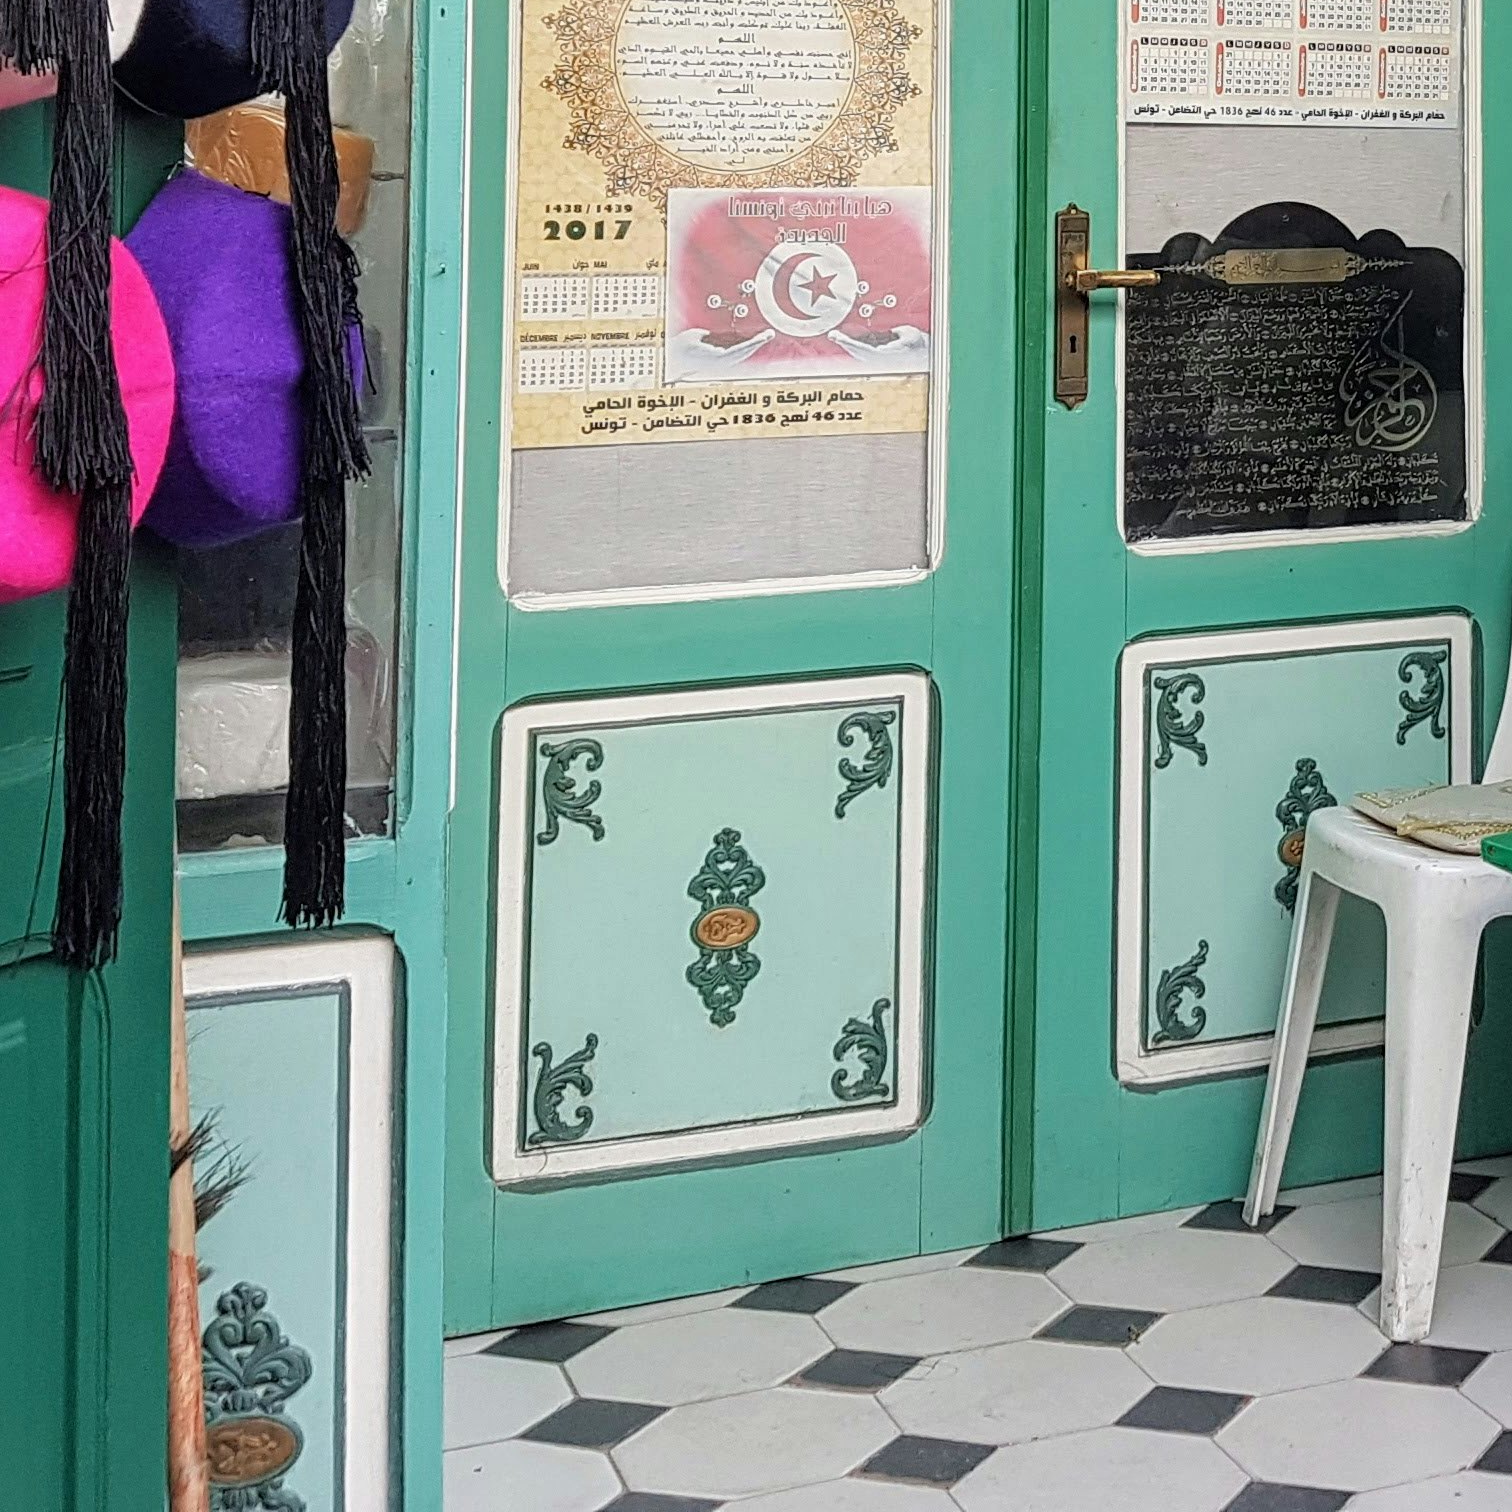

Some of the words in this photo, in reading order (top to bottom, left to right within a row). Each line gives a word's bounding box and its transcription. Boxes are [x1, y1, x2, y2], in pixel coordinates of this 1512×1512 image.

[1220, 106, 1243, 115] 1836
[1264, 107, 1276, 116] 46
[544, 220, 633, 241] 2017
[583, 394, 632, 418] الحامي
[701, 392, 757, 412] الغفران
[762, 395, 771, 408] و
[774, 391, 822, 410] البركة
[826, 390, 864, 406] حمام
[643, 415, 702, 432] التضامن
[706, 413, 730, 431] حي
[733, 413, 776, 425] 1836
[780, 411, 810, 427] نهج
[812, 411, 835, 421] 46
[838, 412, 862, 421] عدد
[581, 415, 627, 434] تونس
